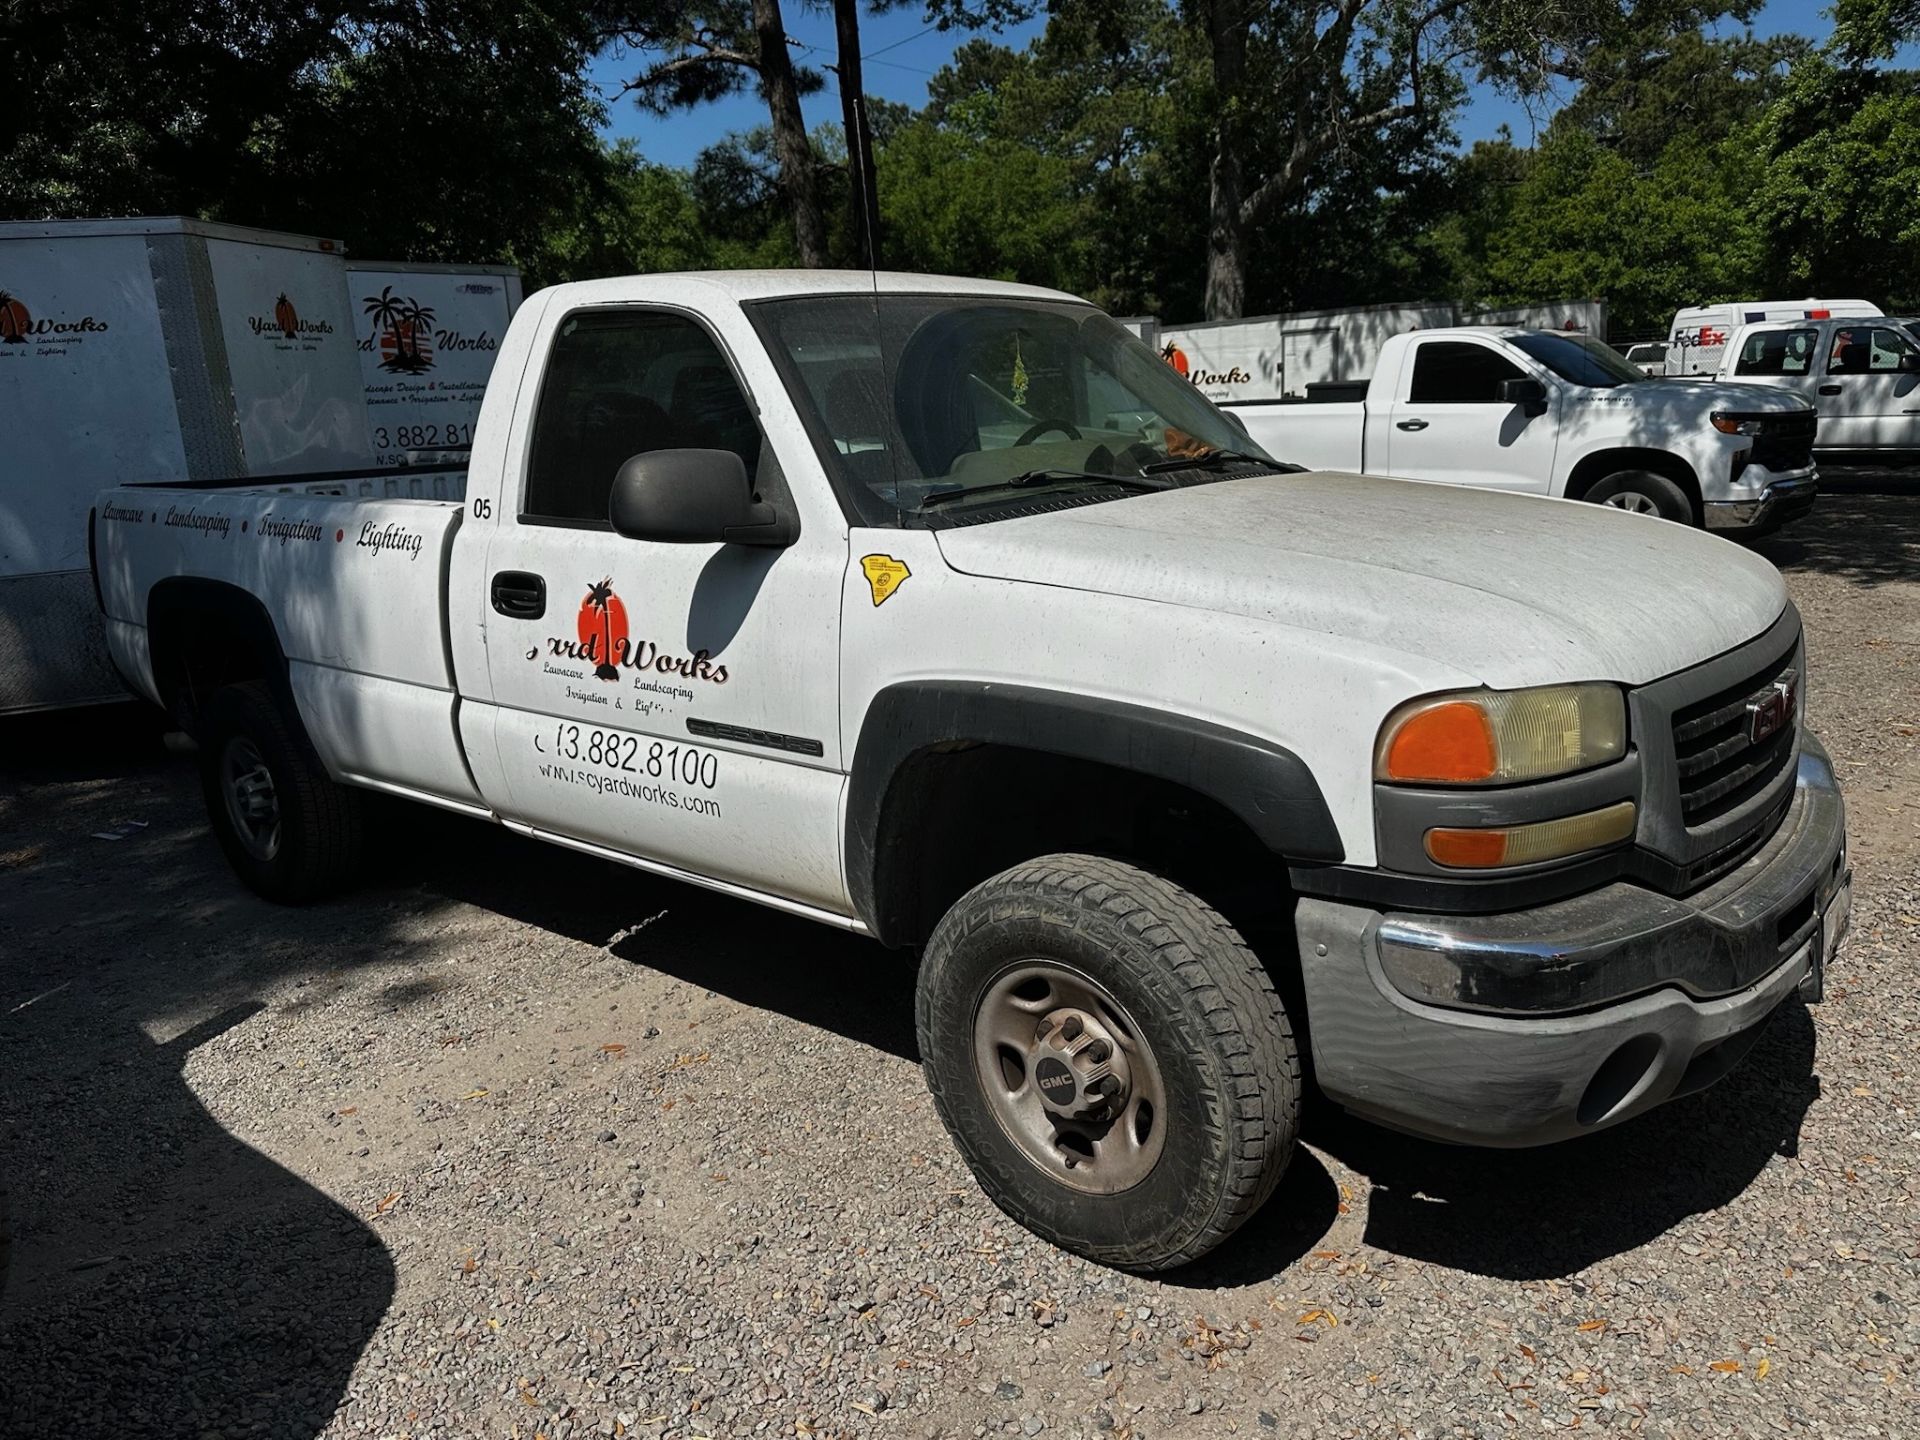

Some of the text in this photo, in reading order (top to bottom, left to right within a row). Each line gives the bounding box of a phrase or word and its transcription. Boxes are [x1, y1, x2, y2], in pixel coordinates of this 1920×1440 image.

[21, 316, 108, 334] Works
[248, 316, 334, 335] Yard Works
[435, 329, 498, 352] Works
[1674, 326, 1726, 348] FedEx
[36, 347, 67, 356] Lighting
[365, 384, 394, 394] dscape
[396, 382, 426, 394] Design
[428, 382, 435, 391] &
[367, 397, 398, 405] tenance
[408, 394, 449, 405] Irrigation
[375, 423, 476, 449] 3.882.81
[473, 497, 491, 520] 05
[102, 500, 423, 561] Lawncare Landscaping Irrigation Lighting
[615, 637, 729, 684] Works
[565, 686, 608, 705] Irrigation
[615, 697, 623, 710] &
[633, 677, 694, 702] Landscaping
[1040, 1073, 1073, 1089] GMC
